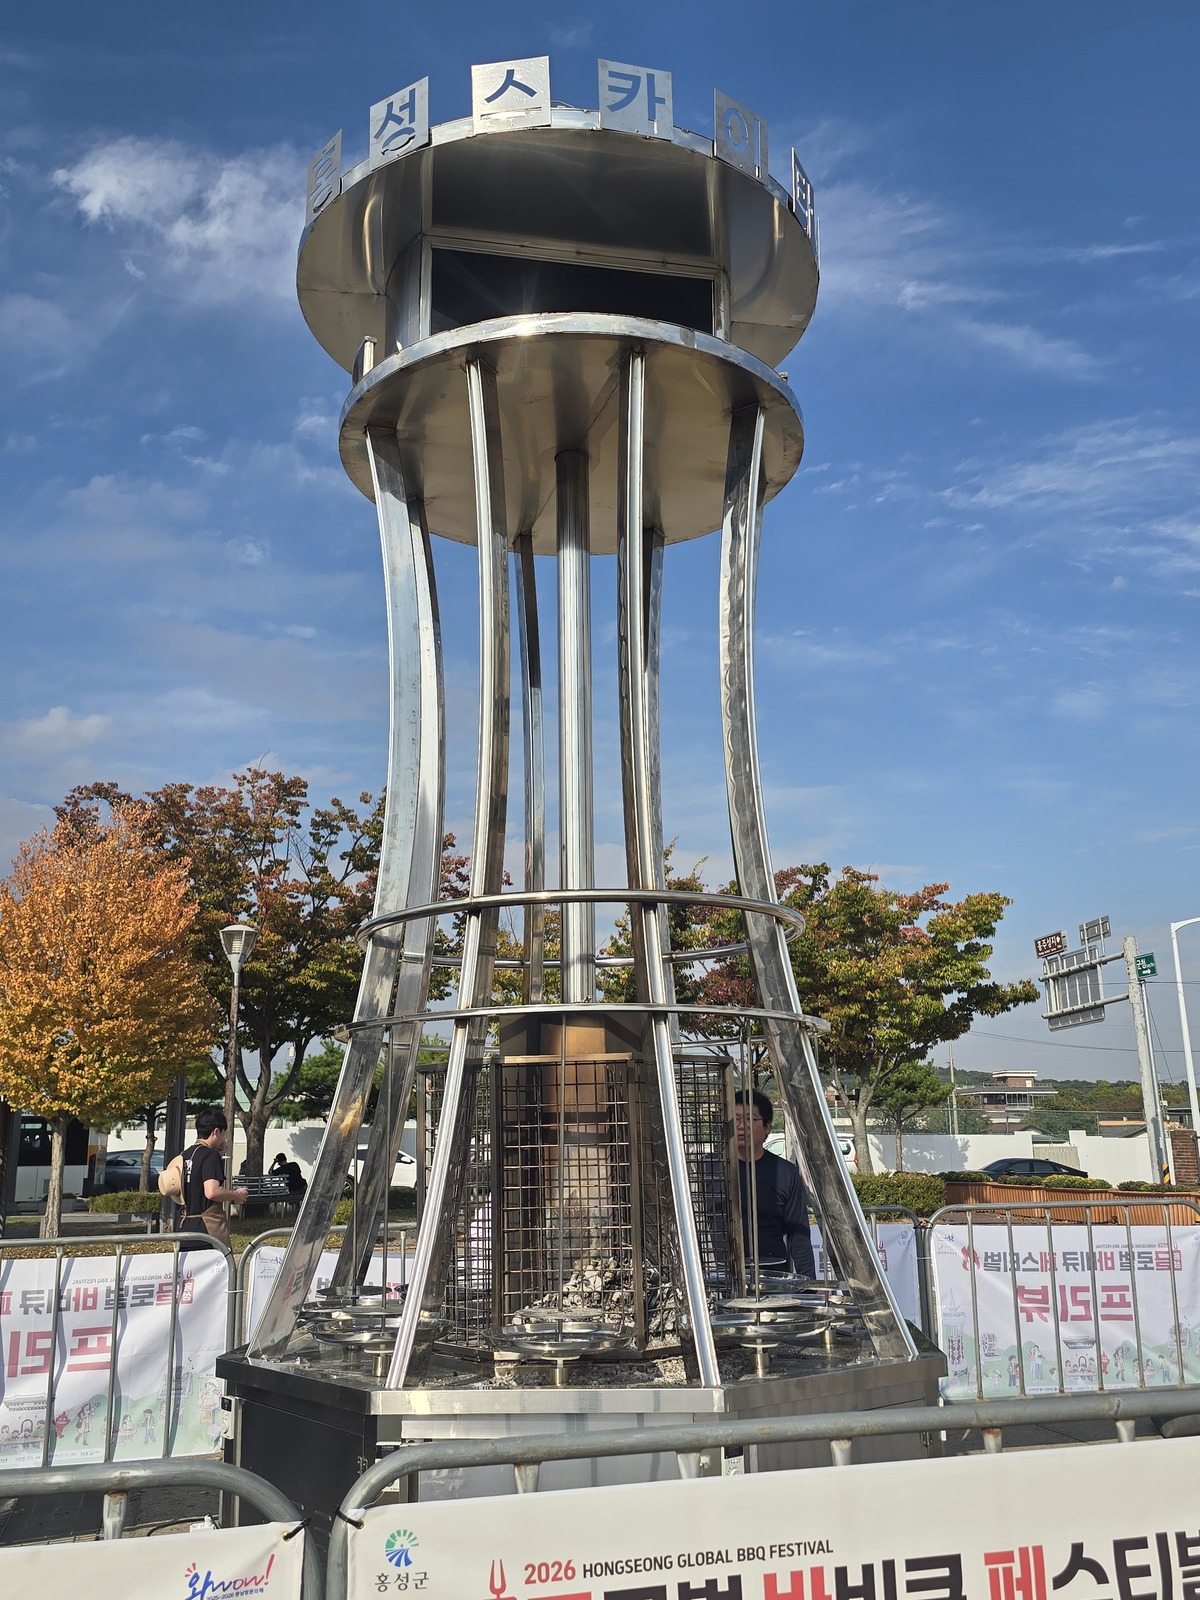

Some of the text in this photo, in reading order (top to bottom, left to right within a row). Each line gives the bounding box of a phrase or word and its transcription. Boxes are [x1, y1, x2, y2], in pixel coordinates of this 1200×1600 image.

[524, 1539, 834, 1585] 2026 HONGSEONG GLOBAL BBQ FESTIVAL
[374, 1571, 430, 1592] 홍성군
